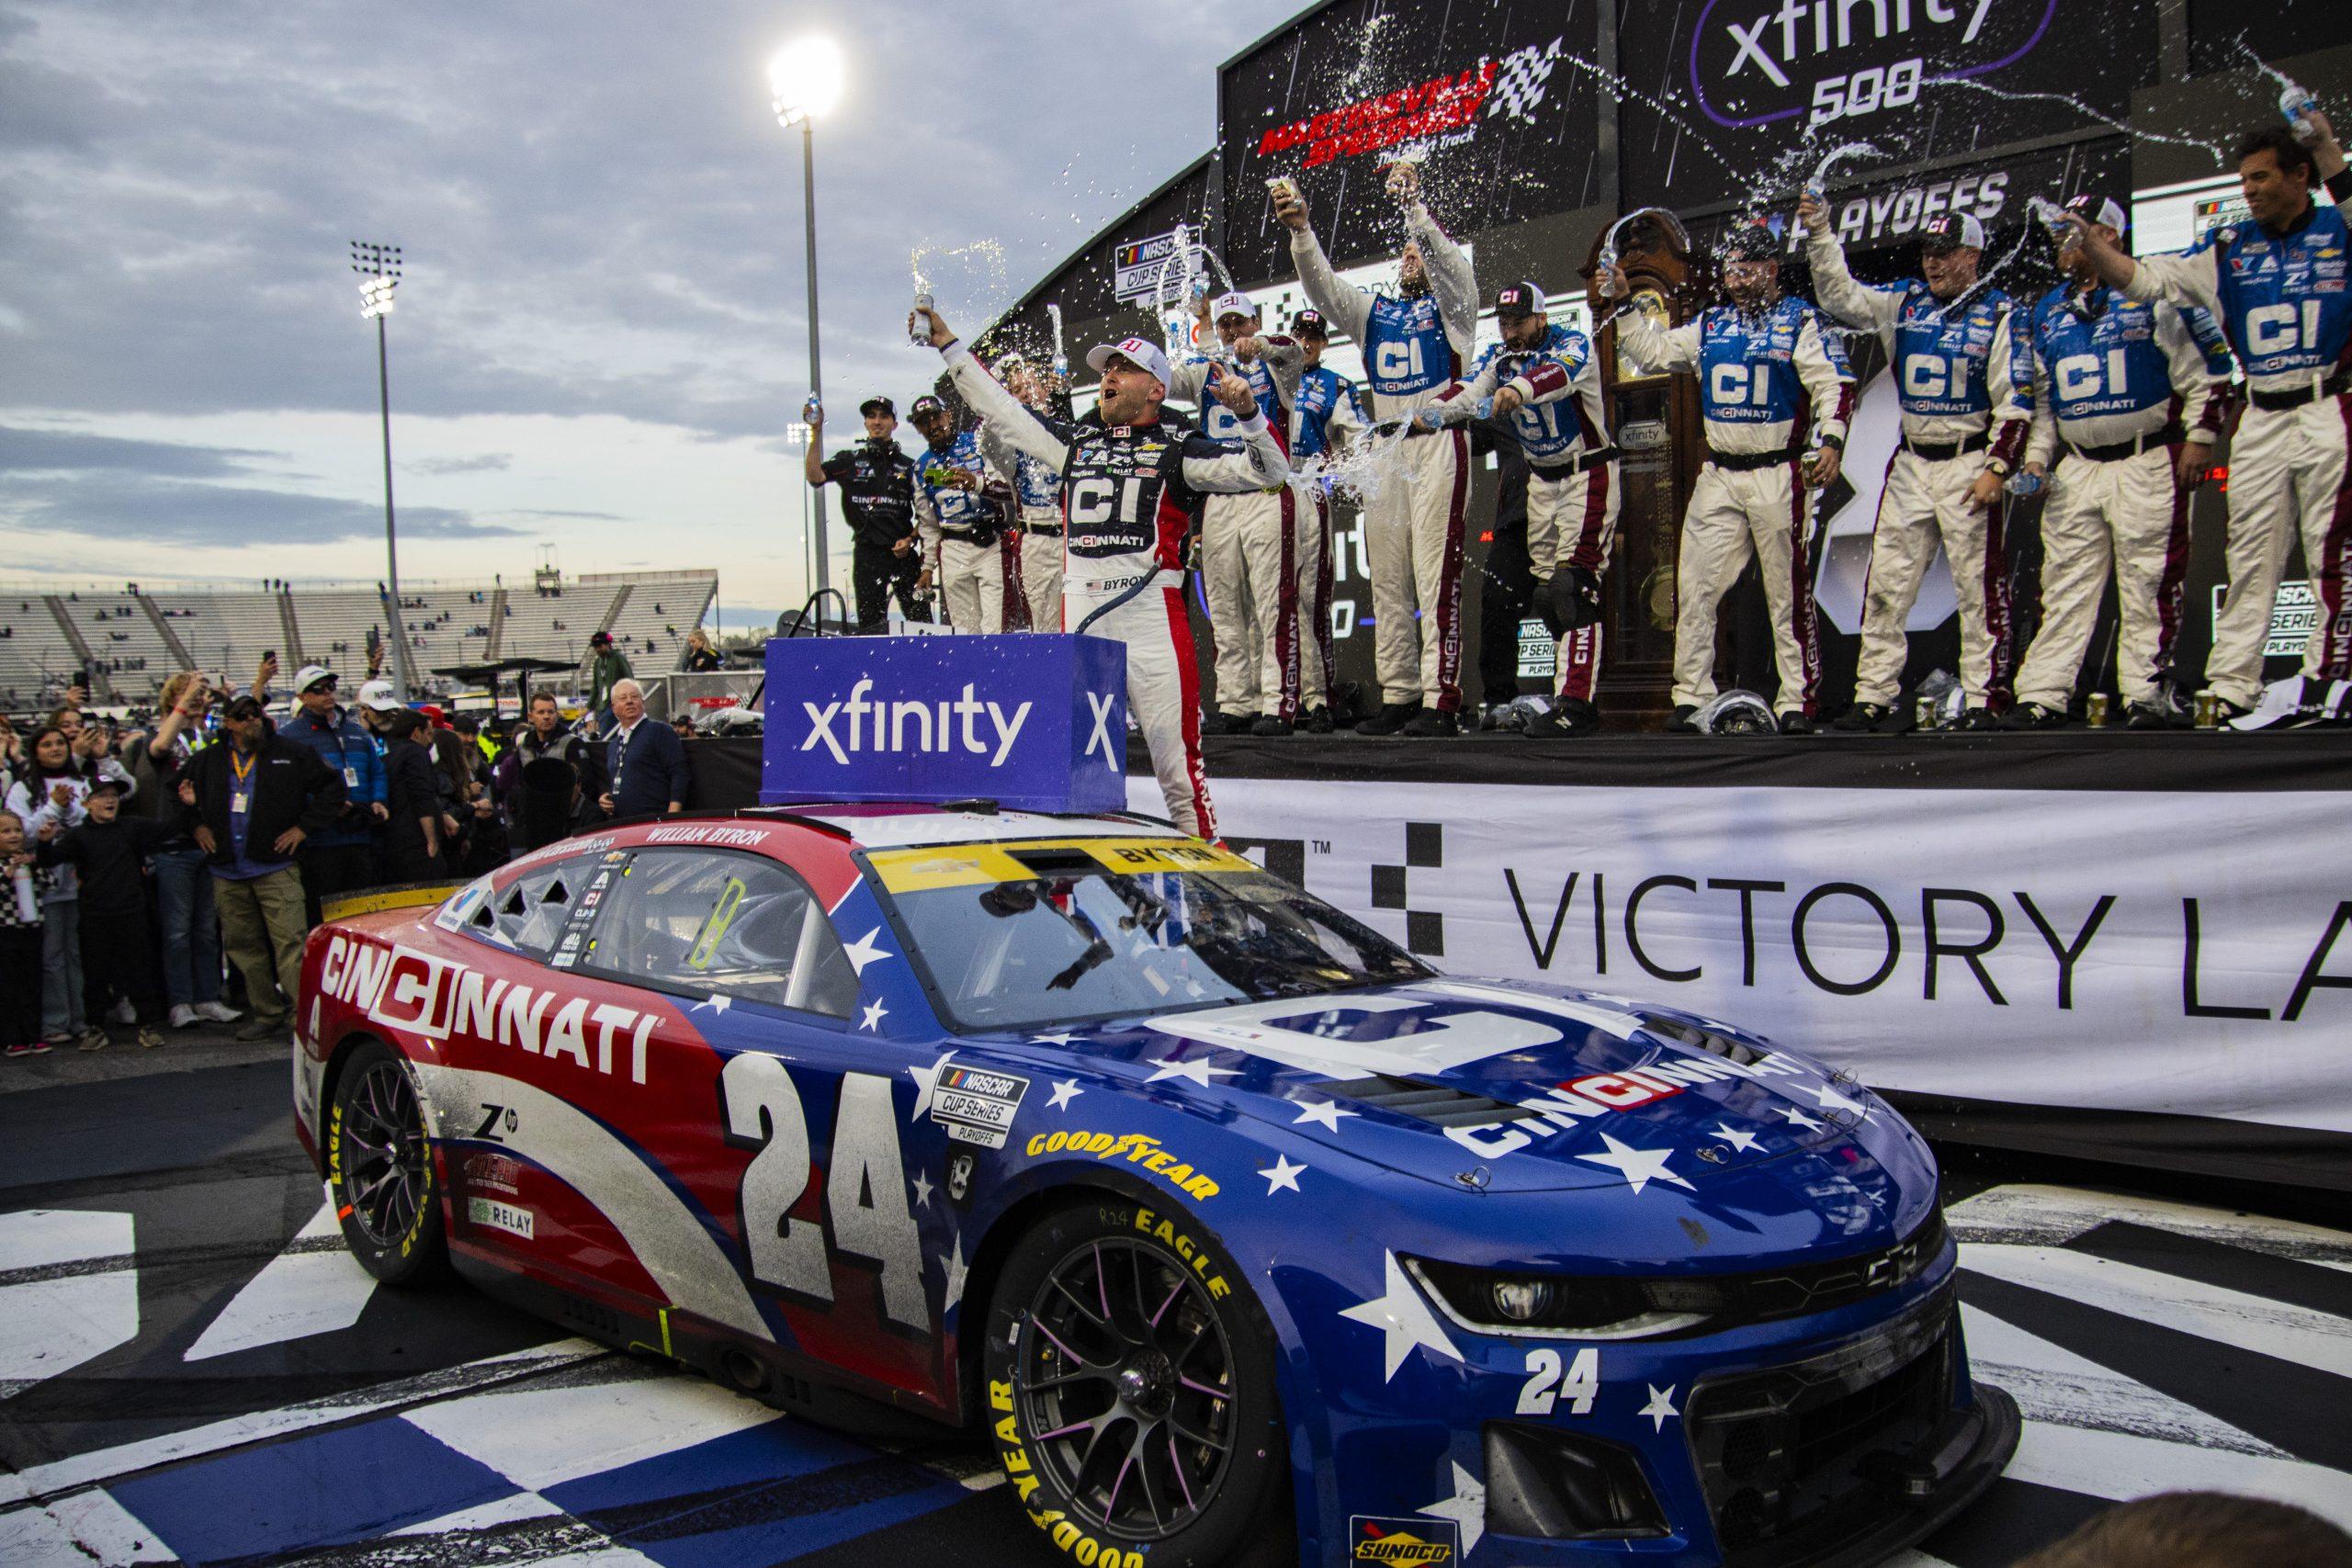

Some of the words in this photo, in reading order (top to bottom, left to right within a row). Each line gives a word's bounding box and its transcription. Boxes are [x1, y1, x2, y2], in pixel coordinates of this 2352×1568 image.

[1811, 58, 1923, 124] 500
[1440, 129, 1476, 150] Track
[1787, 172, 2008, 254] PAYOFFS
[1929, 218, 1950, 233] CI
[1127, 268, 1149, 288] CUP
[1499, 289, 1520, 305] CI
[2246, 299, 2322, 355] CI
[1376, 337, 1425, 379] CI
[1712, 363, 1770, 405] CI
[1905, 354, 1968, 399] CI
[2056, 348, 2127, 401] CI
[1113, 427, 1130, 437] CI
[1625, 428, 1659, 442] xfinity
[1070, 478, 1141, 524] CI
[1069, 535, 1144, 548] CINCINNATI
[2269, 612, 2318, 629] SERIE
[1529, 644, 1555, 657] SERI
[2267, 641, 2306, 652] PLAYO
[1528, 665, 1554, 675] PLAYO
[800, 679, 1032, 767] xfinity
[646, 828, 707, 843] WILLIAM
[707, 829, 770, 845] BYRON
[1312, 840, 1330, 854] TM
[584, 891, 602, 906] CI
[1503, 866, 2117, 1011] VICTORY
[321, 936, 658, 1085] CINCINNATI
[965, 1073, 1014, 1097] NASCAR
[943, 1096, 967, 1113] CUP
[965, 1100, 1004, 1122] SERIES
[472, 1103, 504, 1143] Z
[958, 1126, 995, 1145] PLAYOFFS
[329, 1102, 344, 1185] EAGLE
[1026, 1131, 1220, 1201] GOODYEAR
[721, 1053, 931, 1333] 24
[493, 1206, 531, 1234] RELAY
[1135, 1208, 1231, 1301] EAGLE
[1515, 1348, 1600, 1416] 24
[1360, 1543, 1447, 1561] SUNOCO
